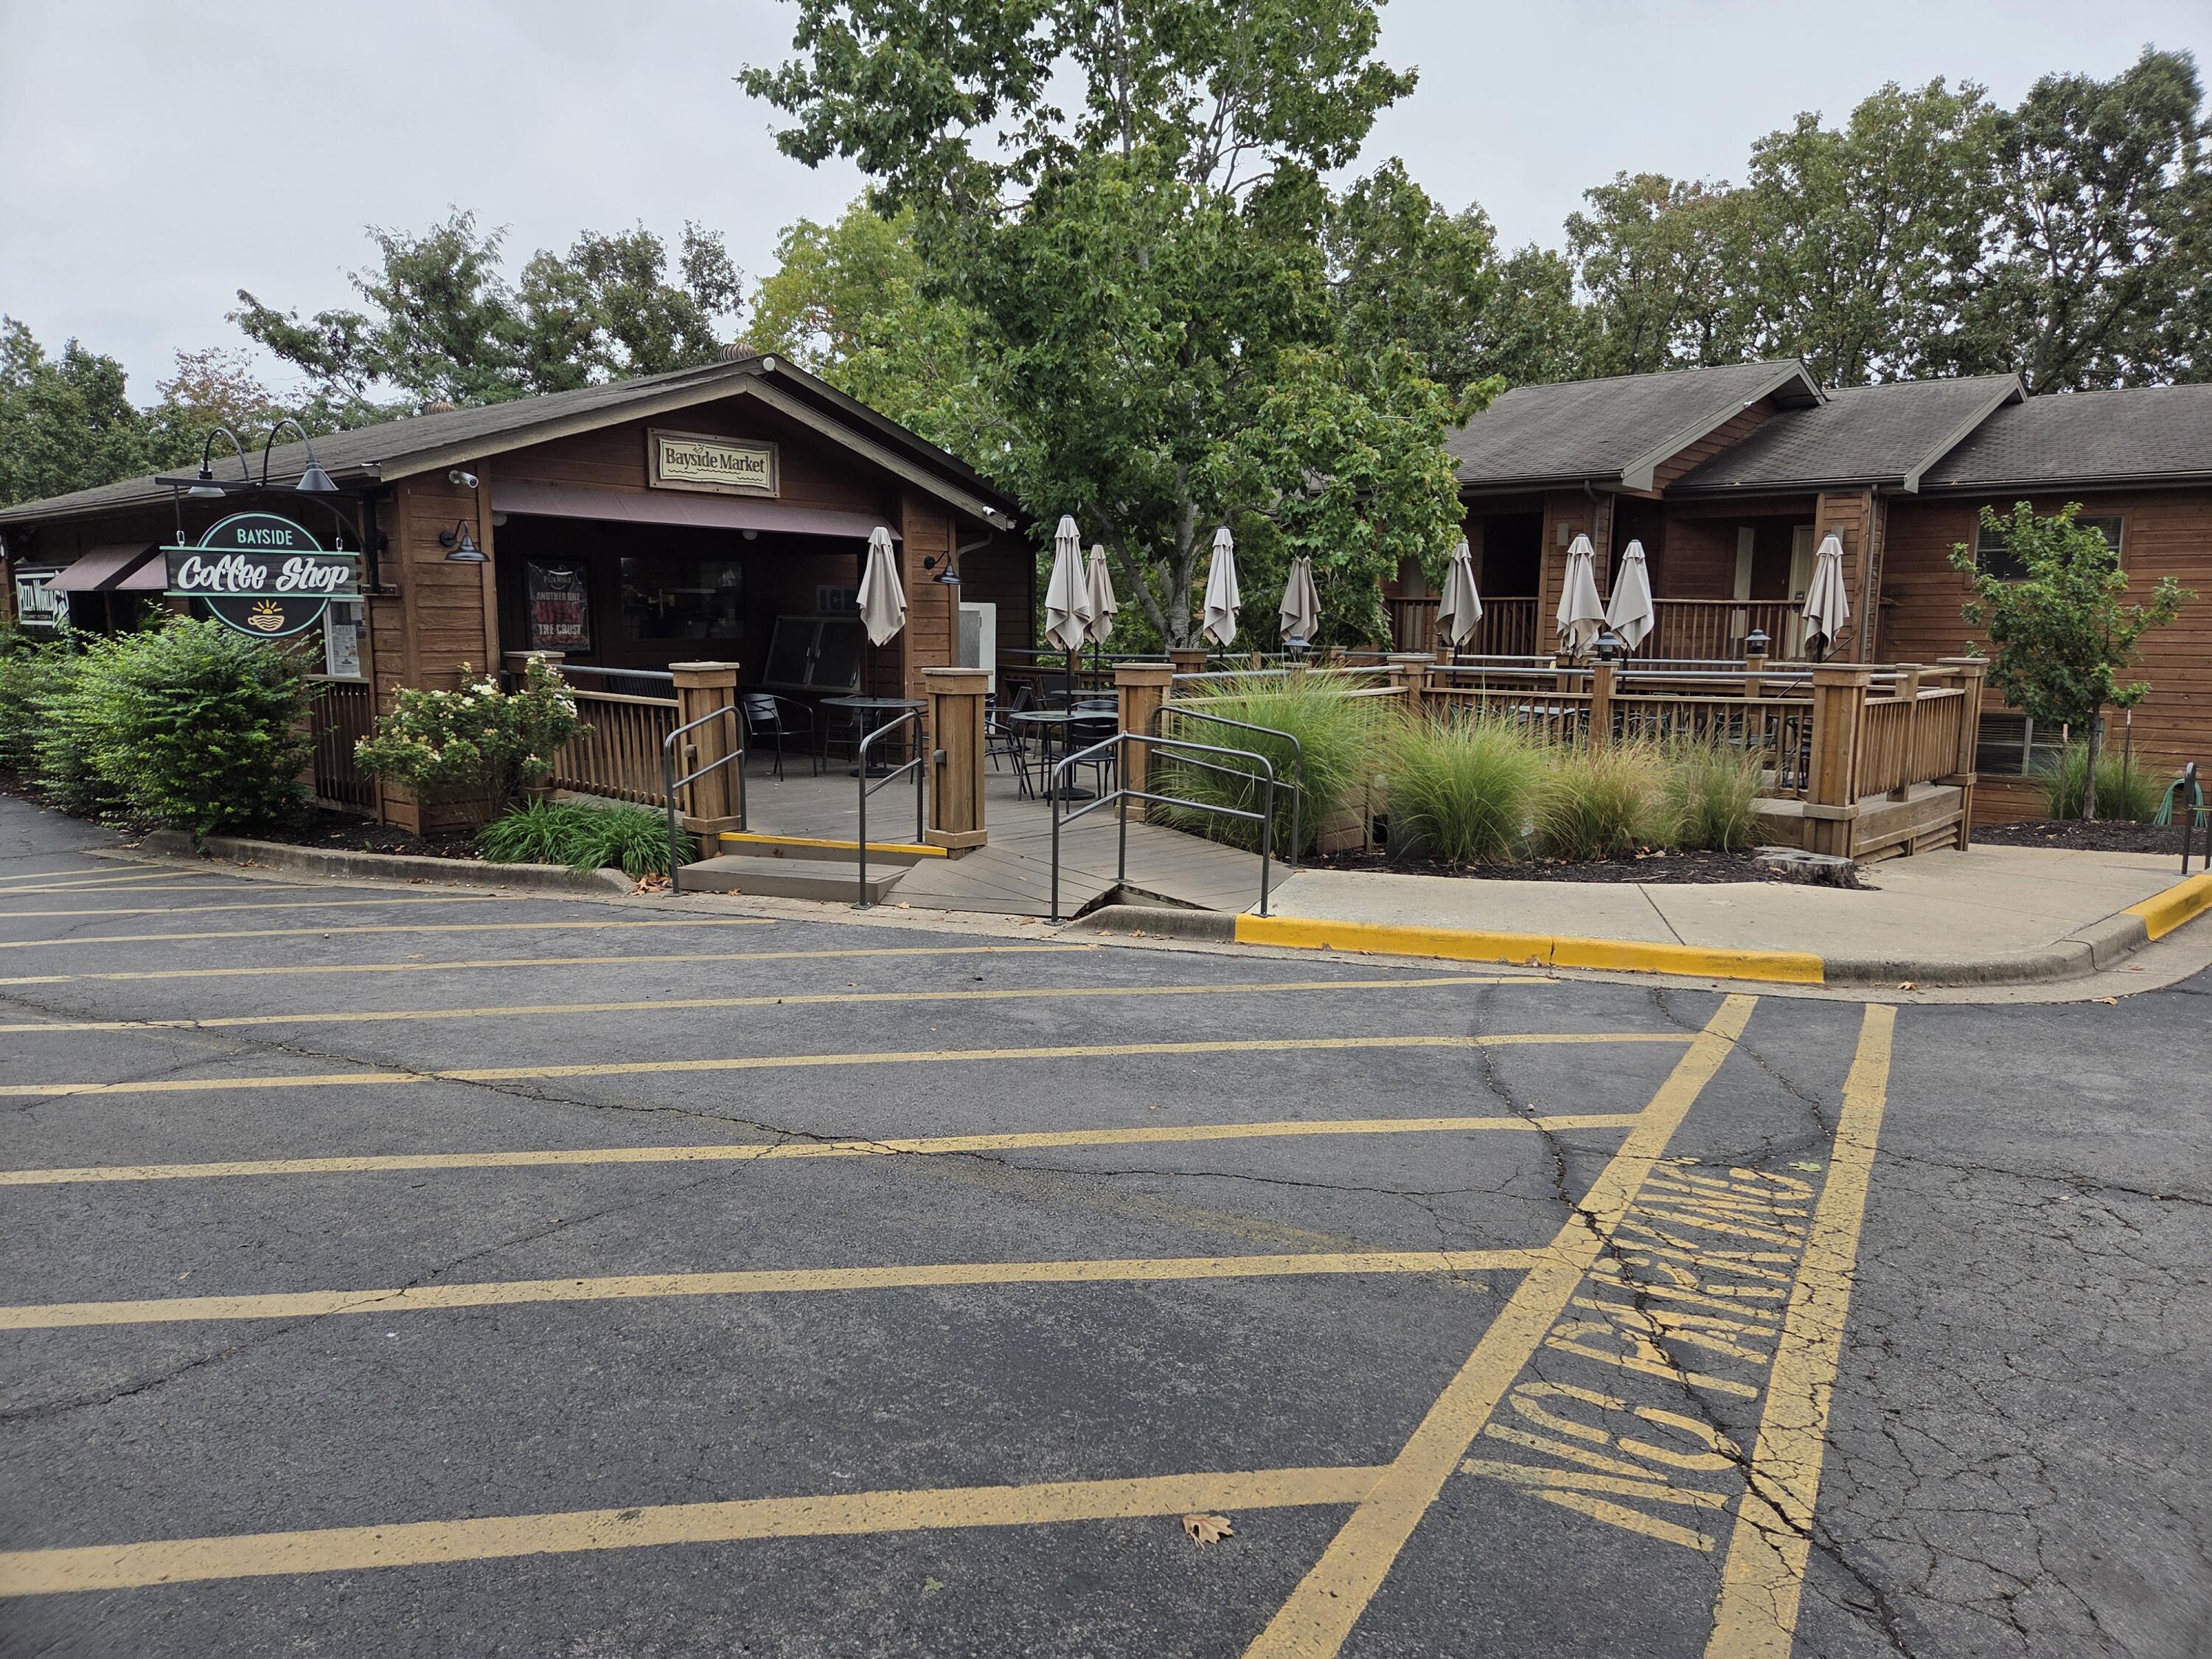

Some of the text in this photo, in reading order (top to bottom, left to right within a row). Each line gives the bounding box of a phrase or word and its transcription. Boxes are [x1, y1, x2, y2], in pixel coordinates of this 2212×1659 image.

[665, 448, 765, 473] Bayside Market
[237, 528, 293, 546] BAYSIDE
[177, 554, 349, 593] Coffee Shop
[536, 591, 580, 601] ANOTHER ONE
[820, 589, 857, 610] ICE
[538, 624, 582, 635] THE CRUST
[1459, 1157, 1815, 1551] NO PARKING
